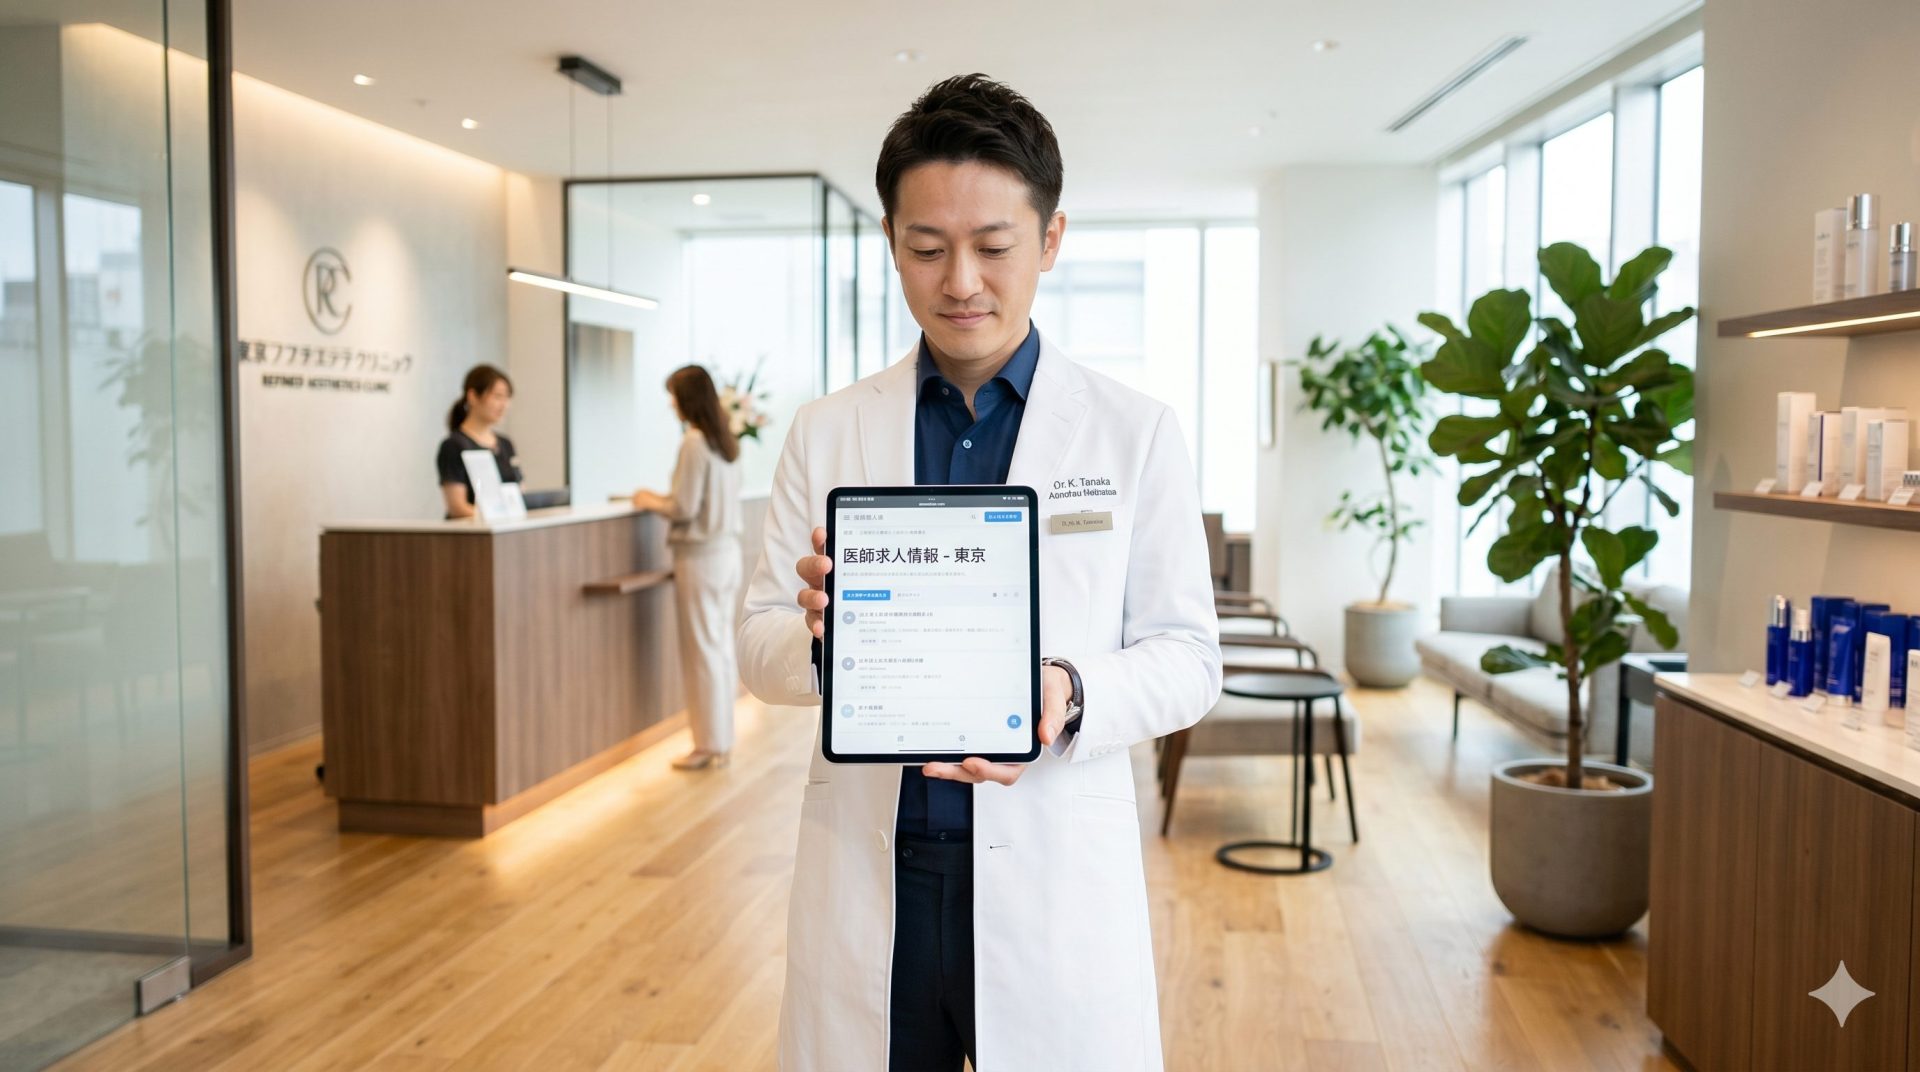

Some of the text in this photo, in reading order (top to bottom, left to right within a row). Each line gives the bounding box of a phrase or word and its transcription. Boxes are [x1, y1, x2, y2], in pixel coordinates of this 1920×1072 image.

[1068, 478, 1079, 488] K.
[1079, 477, 1111, 487] Tanaka
[954, 547, 986, 564] 東京
